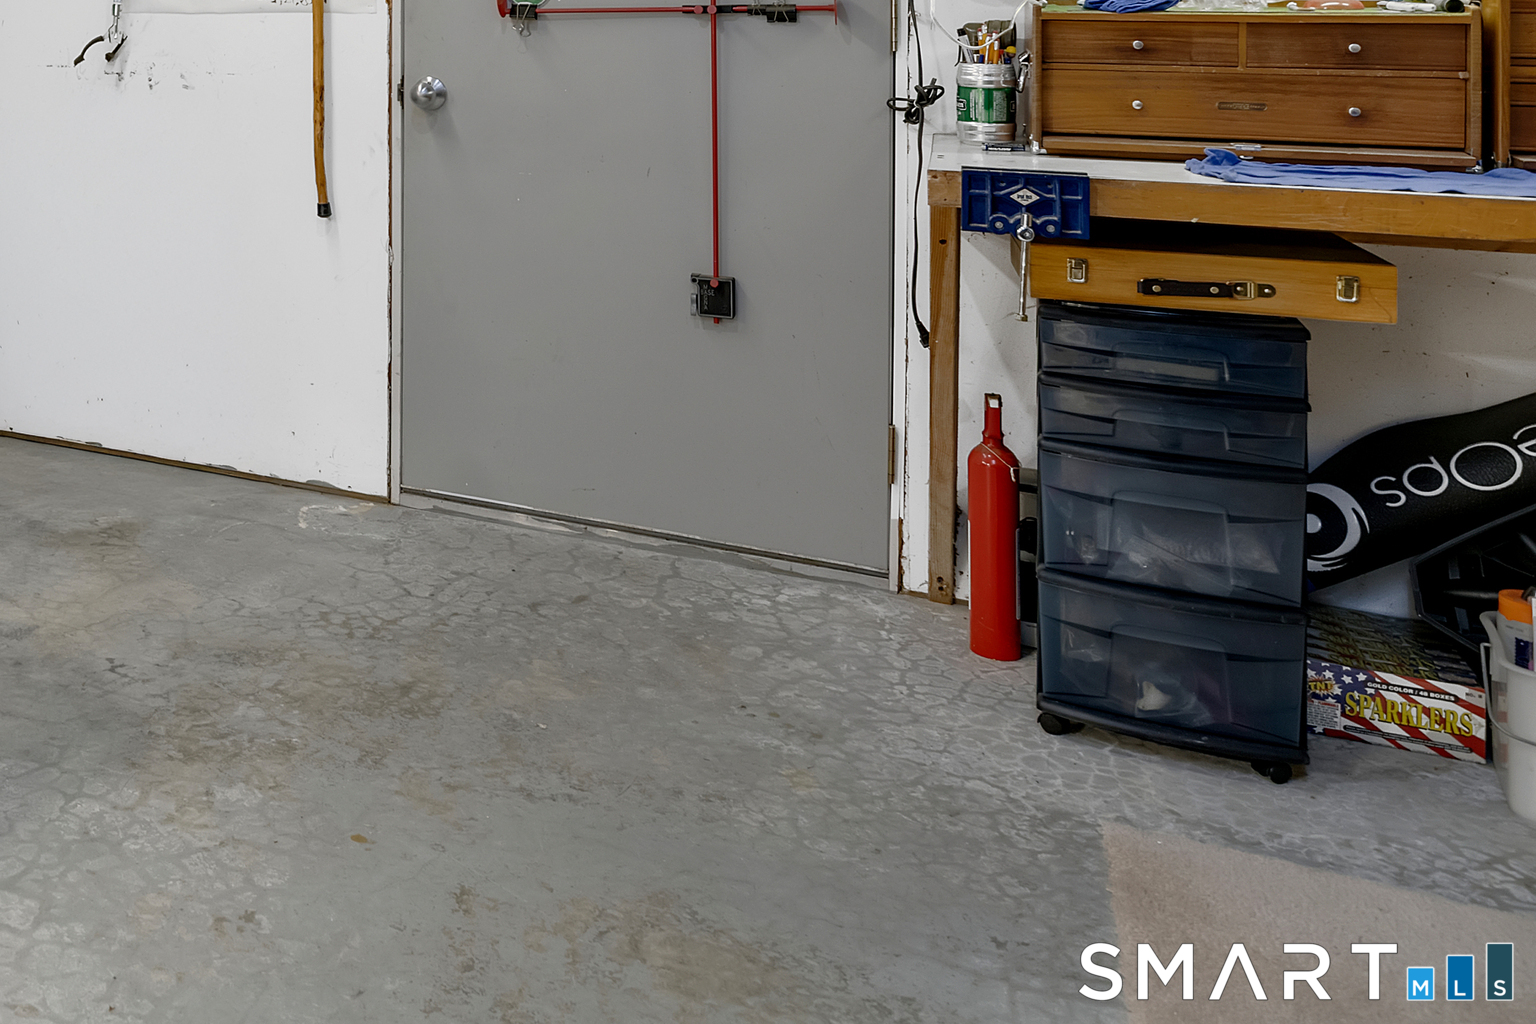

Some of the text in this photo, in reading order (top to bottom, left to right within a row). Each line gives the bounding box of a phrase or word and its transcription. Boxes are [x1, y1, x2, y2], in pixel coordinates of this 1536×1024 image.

[1309, 681, 1332, 692] TNT
[1367, 681, 1388, 690] GOLD
[1388, 685, 1414, 695] COLOR
[1429, 692, 1455, 701] BOXES
[1345, 691, 1474, 737] SPARKLERS
